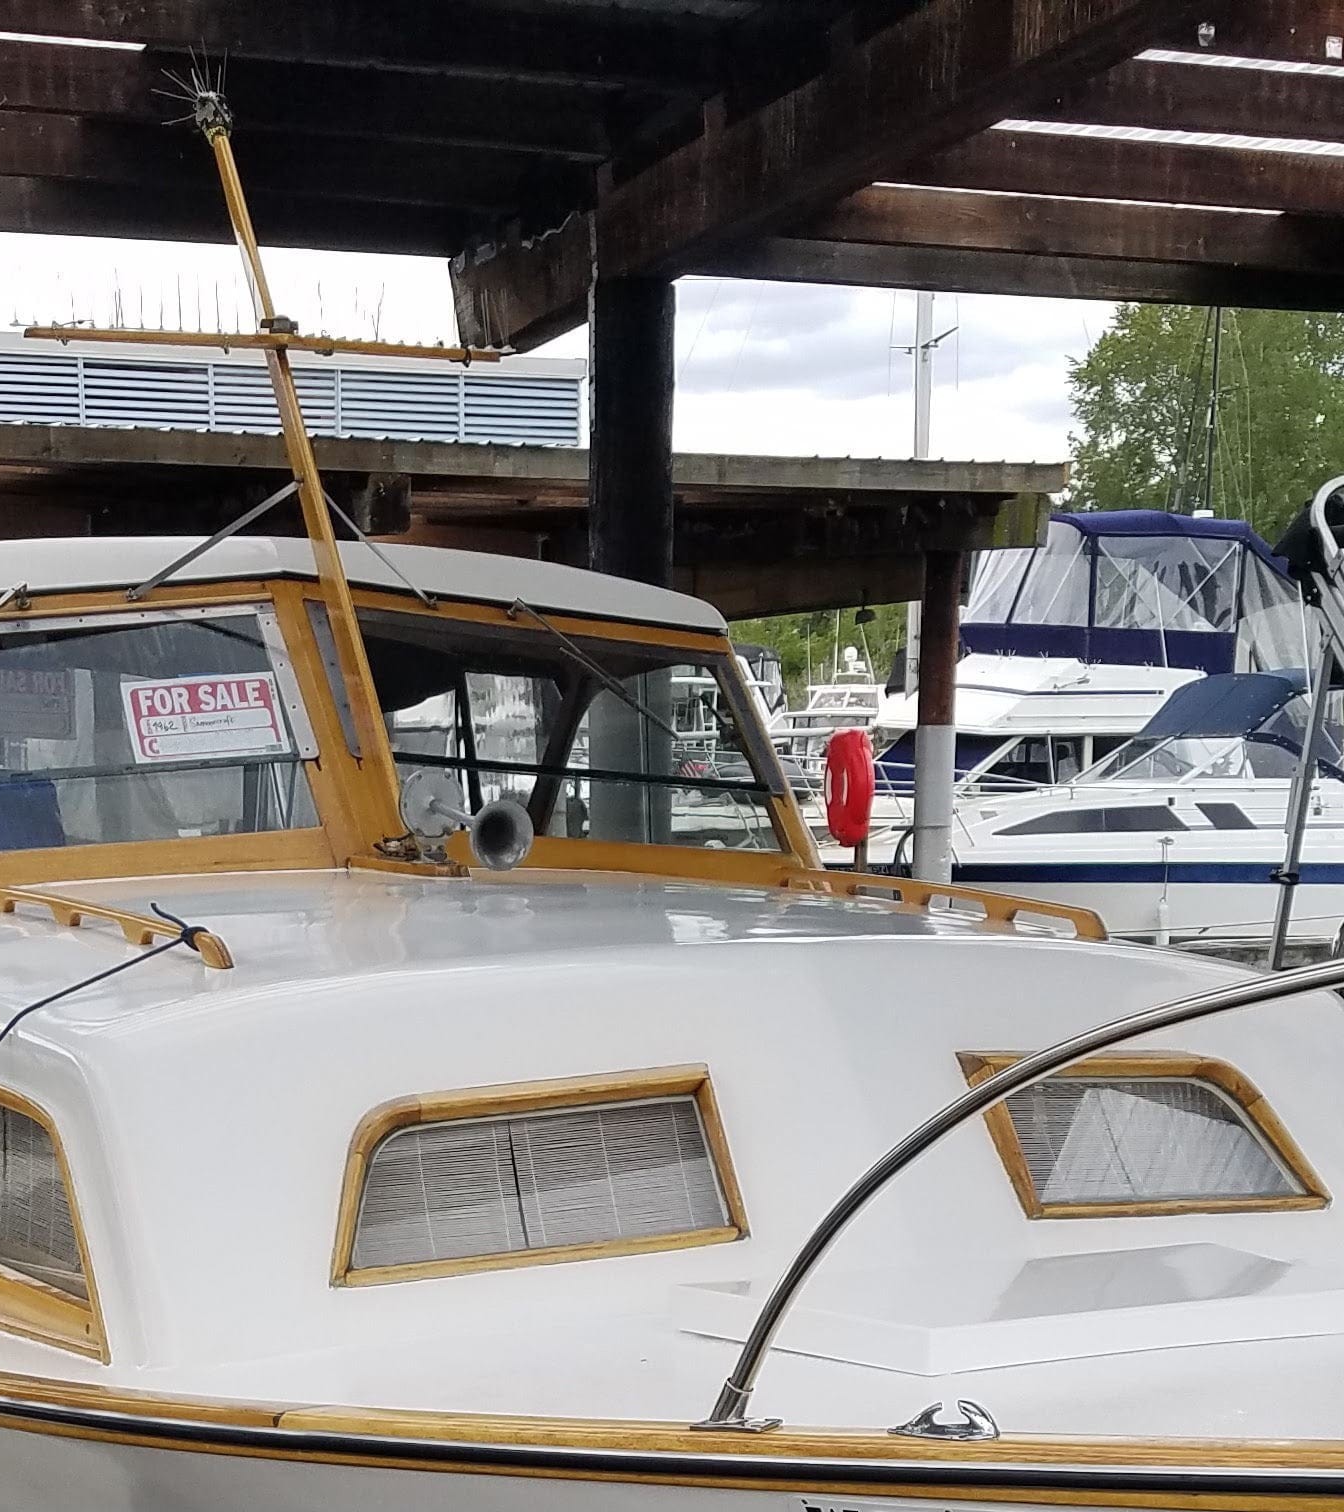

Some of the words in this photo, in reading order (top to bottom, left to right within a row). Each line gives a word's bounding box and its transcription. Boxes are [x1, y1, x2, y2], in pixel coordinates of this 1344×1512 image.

[138, 687, 192, 715] FOR
[198, 681, 264, 711] SALE
[153, 720, 179, 733] 1962
